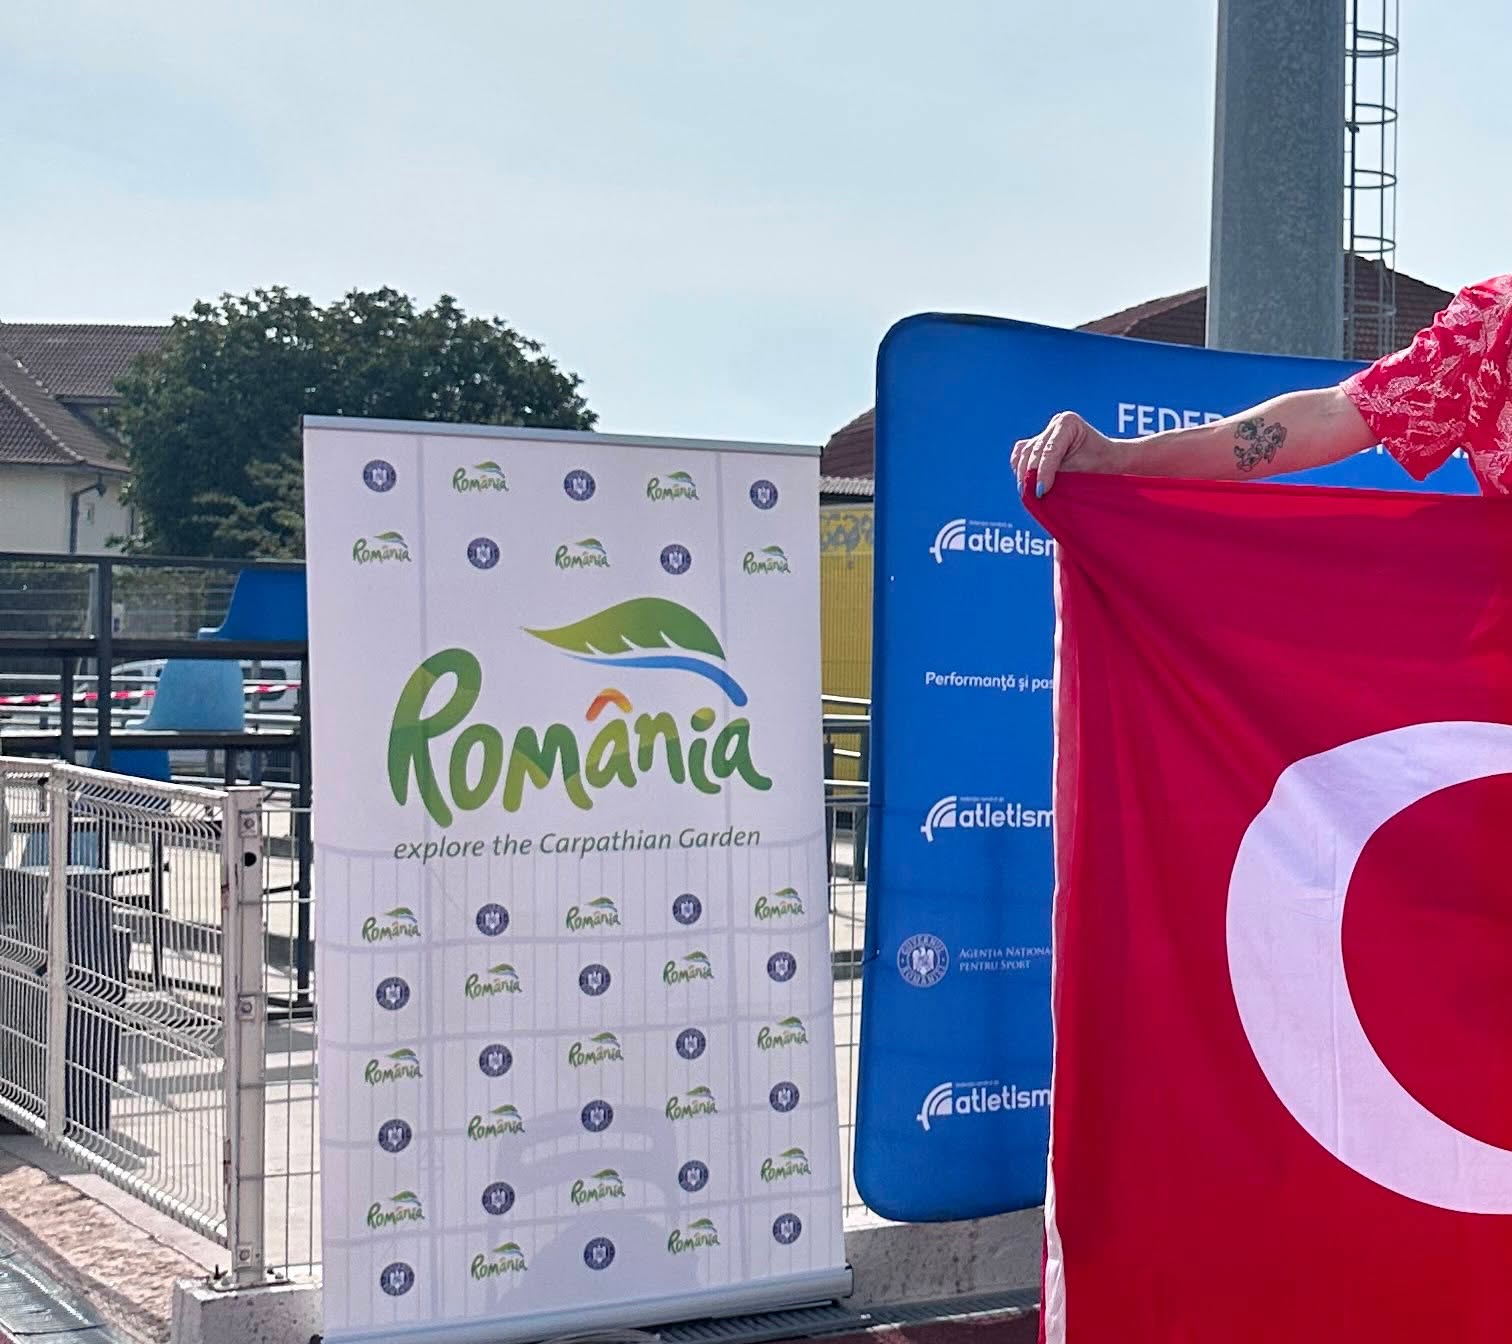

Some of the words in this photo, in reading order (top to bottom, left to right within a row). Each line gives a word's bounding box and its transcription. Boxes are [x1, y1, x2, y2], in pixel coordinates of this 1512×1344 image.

[388, 648, 773, 828] România
[394, 835, 485, 864] explore
[493, 833, 532, 856] the
[540, 830, 671, 859] Carpathian
[679, 826, 760, 848] Garden
[955, 1084, 1051, 1114] atletism
